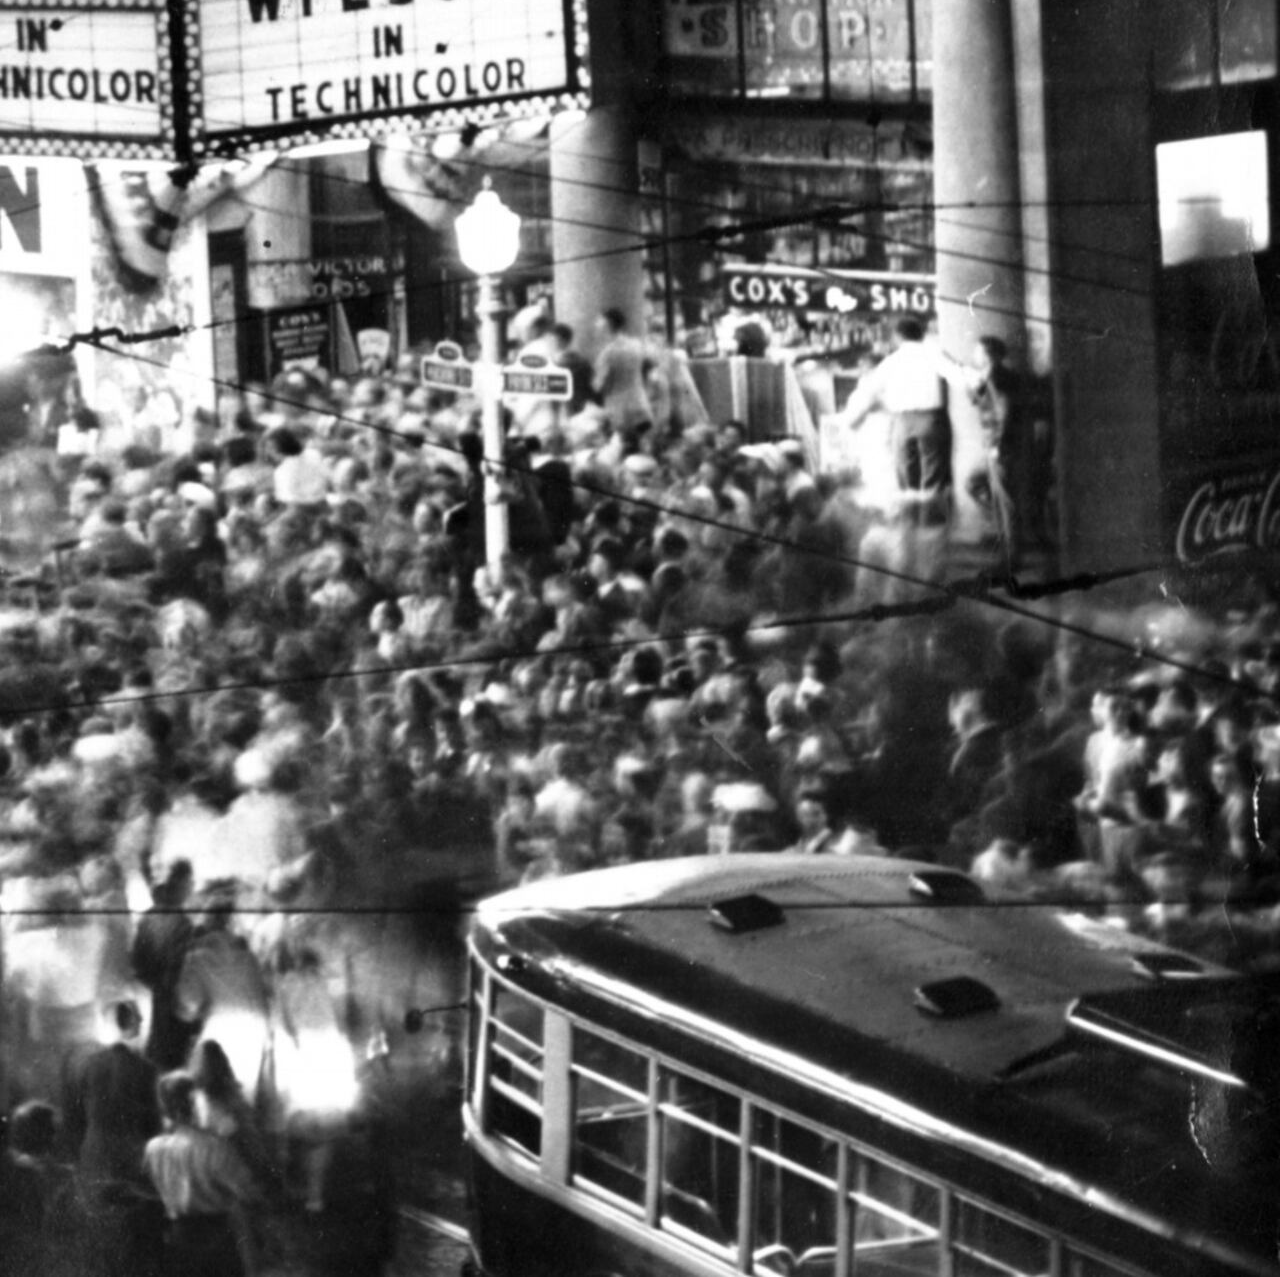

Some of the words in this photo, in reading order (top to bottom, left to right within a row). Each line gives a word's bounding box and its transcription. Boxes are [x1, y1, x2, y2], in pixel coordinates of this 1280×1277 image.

[16, 18, 49, 52] IN
[373, 24, 404, 60] IN
[265, 57, 526, 122] TECHNICOLOR
[308, 255, 387, 276] VICTOR
[729, 275, 810, 307] COX'S
[1176, 468, 1280, 567] Coca-C
